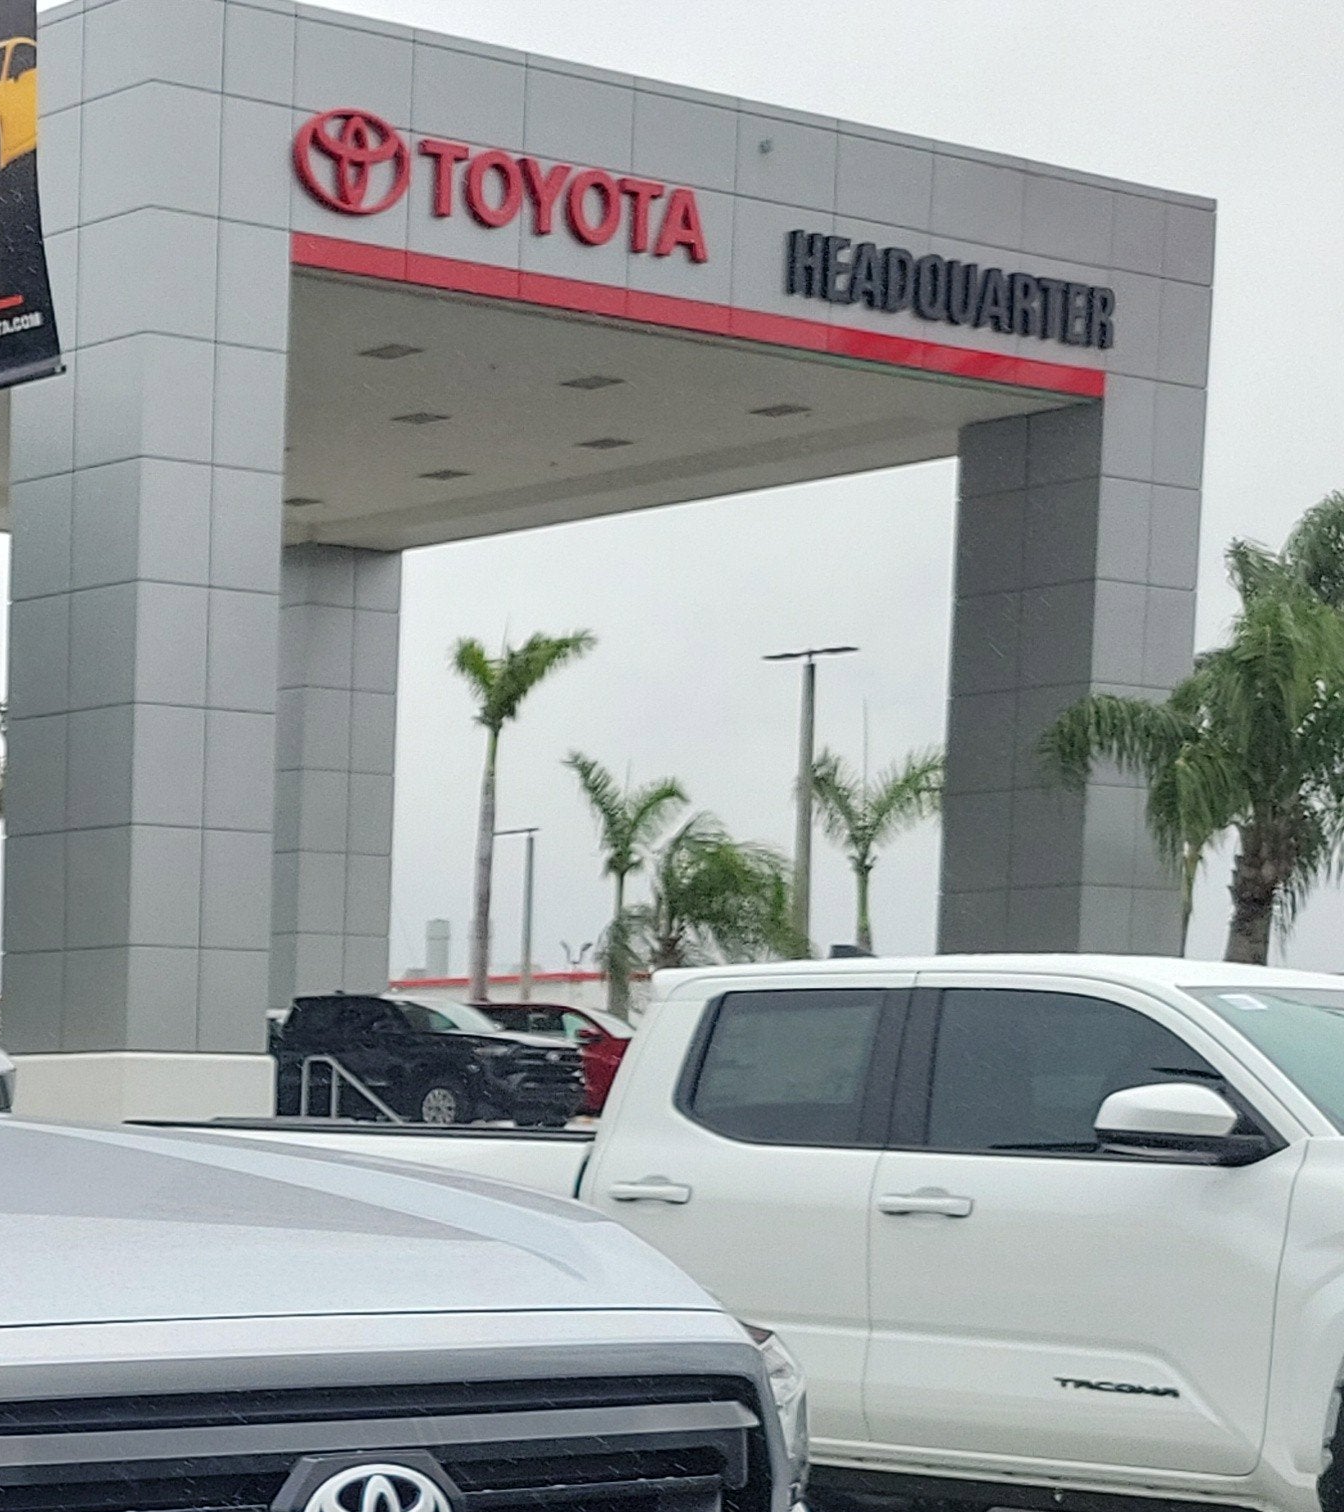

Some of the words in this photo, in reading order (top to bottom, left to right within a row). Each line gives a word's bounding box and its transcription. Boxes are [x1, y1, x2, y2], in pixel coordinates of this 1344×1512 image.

[418, 139, 709, 264] TOYOTA
[784, 228, 1115, 350] HEADQUARTER
[1053, 1376, 1180, 1398] TACOMA
